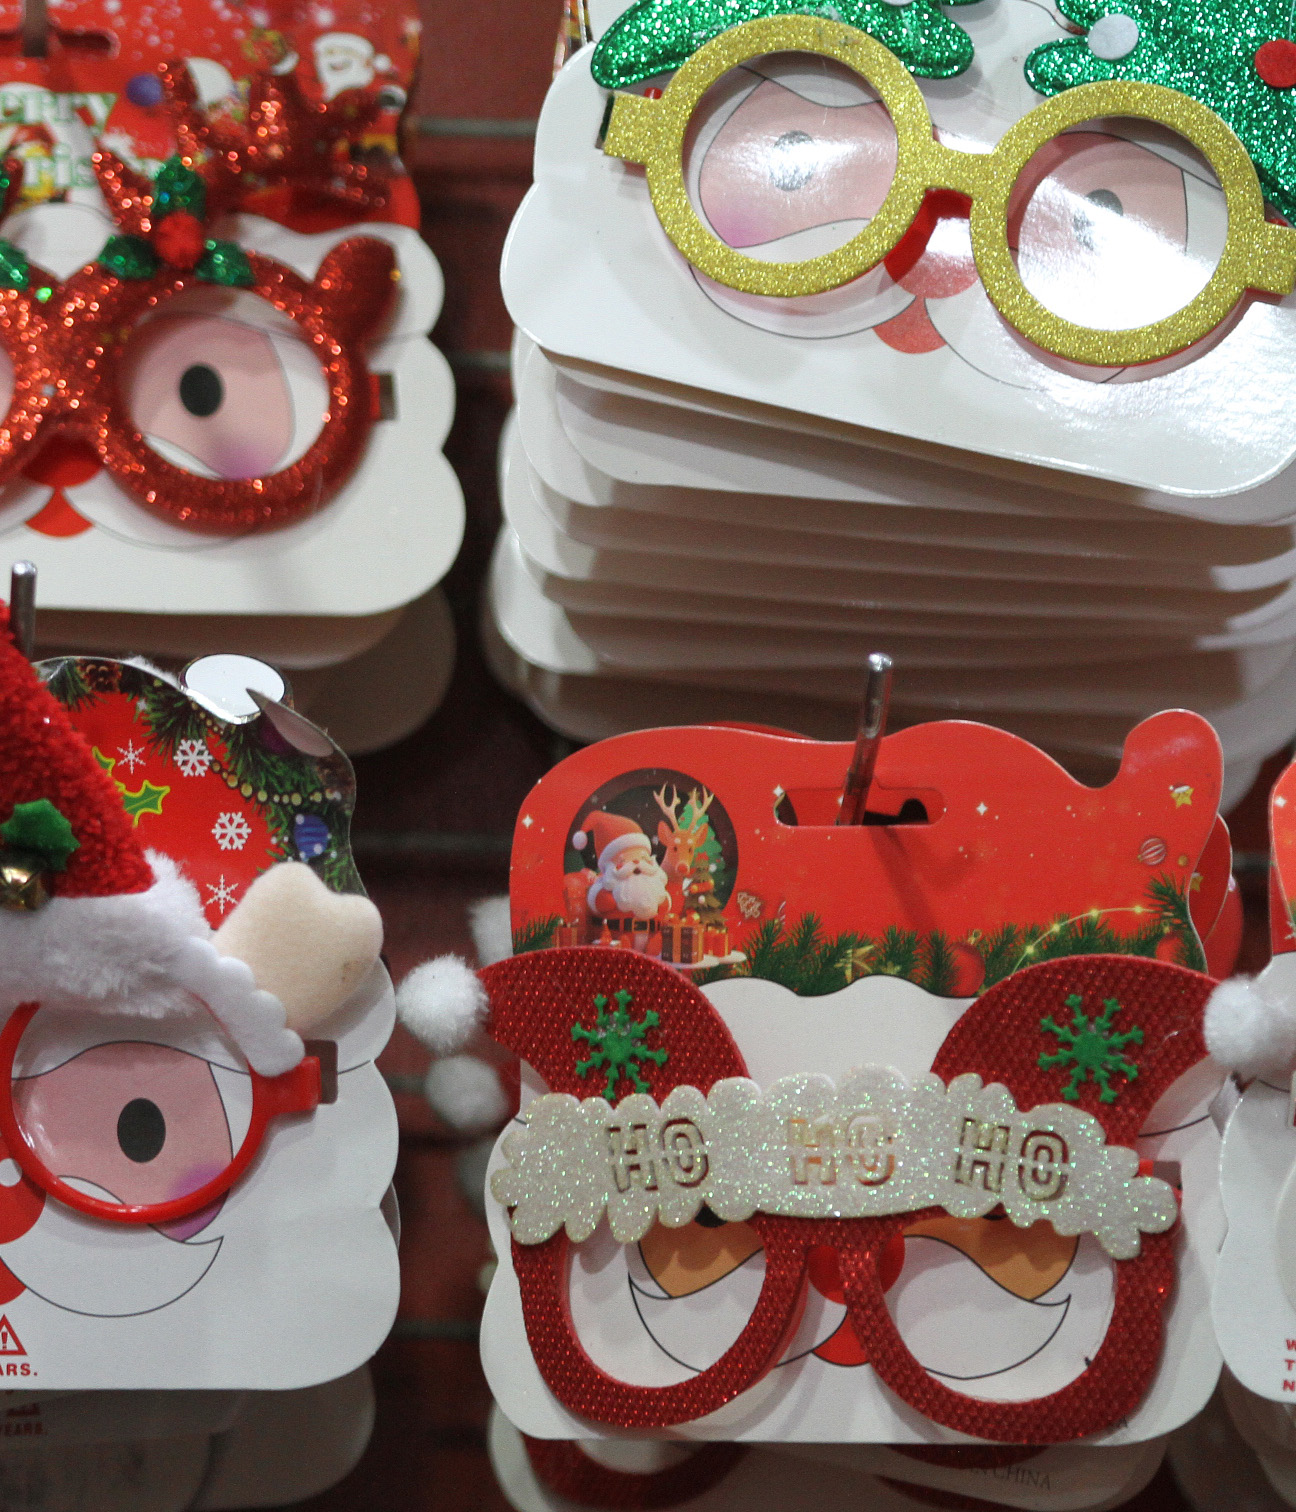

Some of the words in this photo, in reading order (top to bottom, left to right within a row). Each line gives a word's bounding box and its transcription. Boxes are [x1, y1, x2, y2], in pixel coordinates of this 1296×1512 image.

[606, 1116, 710, 1194] HO
[788, 1114, 895, 1188] HO
[954, 1116, 1070, 1201] HO
